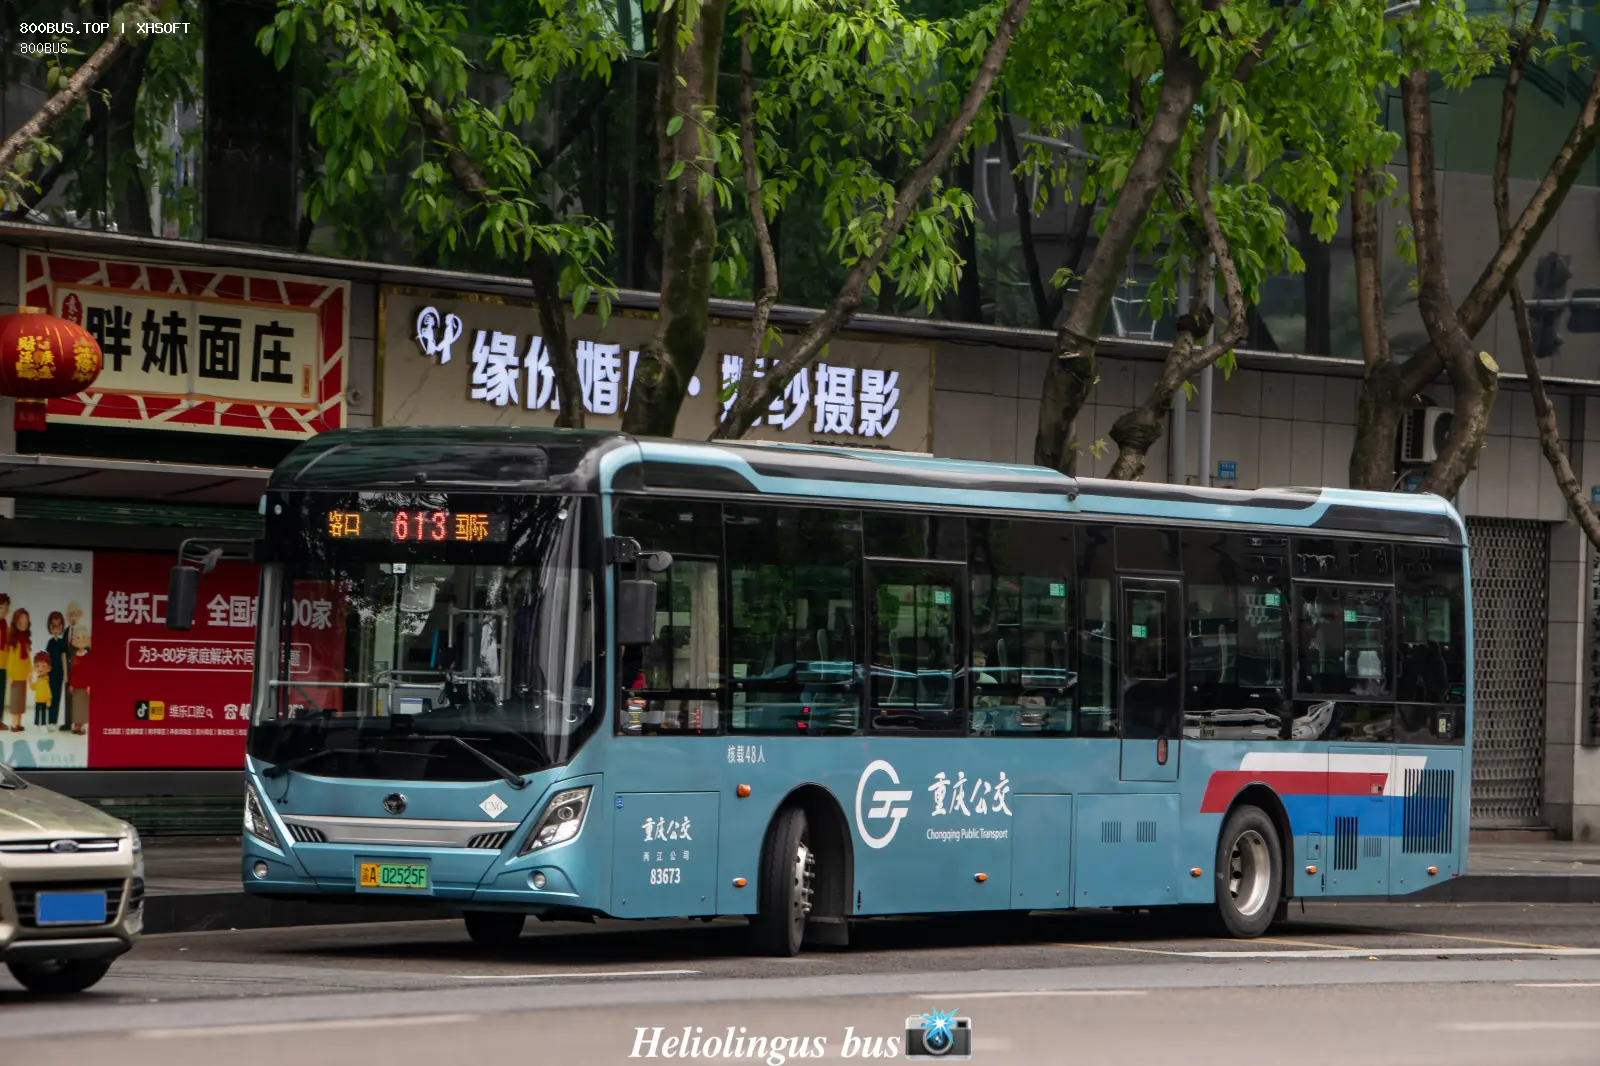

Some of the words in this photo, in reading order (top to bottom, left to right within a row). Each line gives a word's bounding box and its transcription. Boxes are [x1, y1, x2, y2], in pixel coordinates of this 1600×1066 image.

[86, 305, 294, 384] 胖妹面庄
[394, 510, 447, 541] 613
[12, 560, 46, 573] 维乐口腔
[104, 589, 196, 627] 维乐口
[168, 704, 206, 719] 维乐口腔
[727, 744, 766, 764] 核载48人
[928, 772, 1012, 816] 重庆公交
[484, 801, 503, 812] CNG
[641, 815, 693, 842] 重庆公交
[926, 829, 960, 842] Chongqing
[961, 828, 979, 839] Public
[980, 828, 1008, 841] Transport
[382, 867, 427, 886] 02525F
[650, 867, 681, 885] 83673
